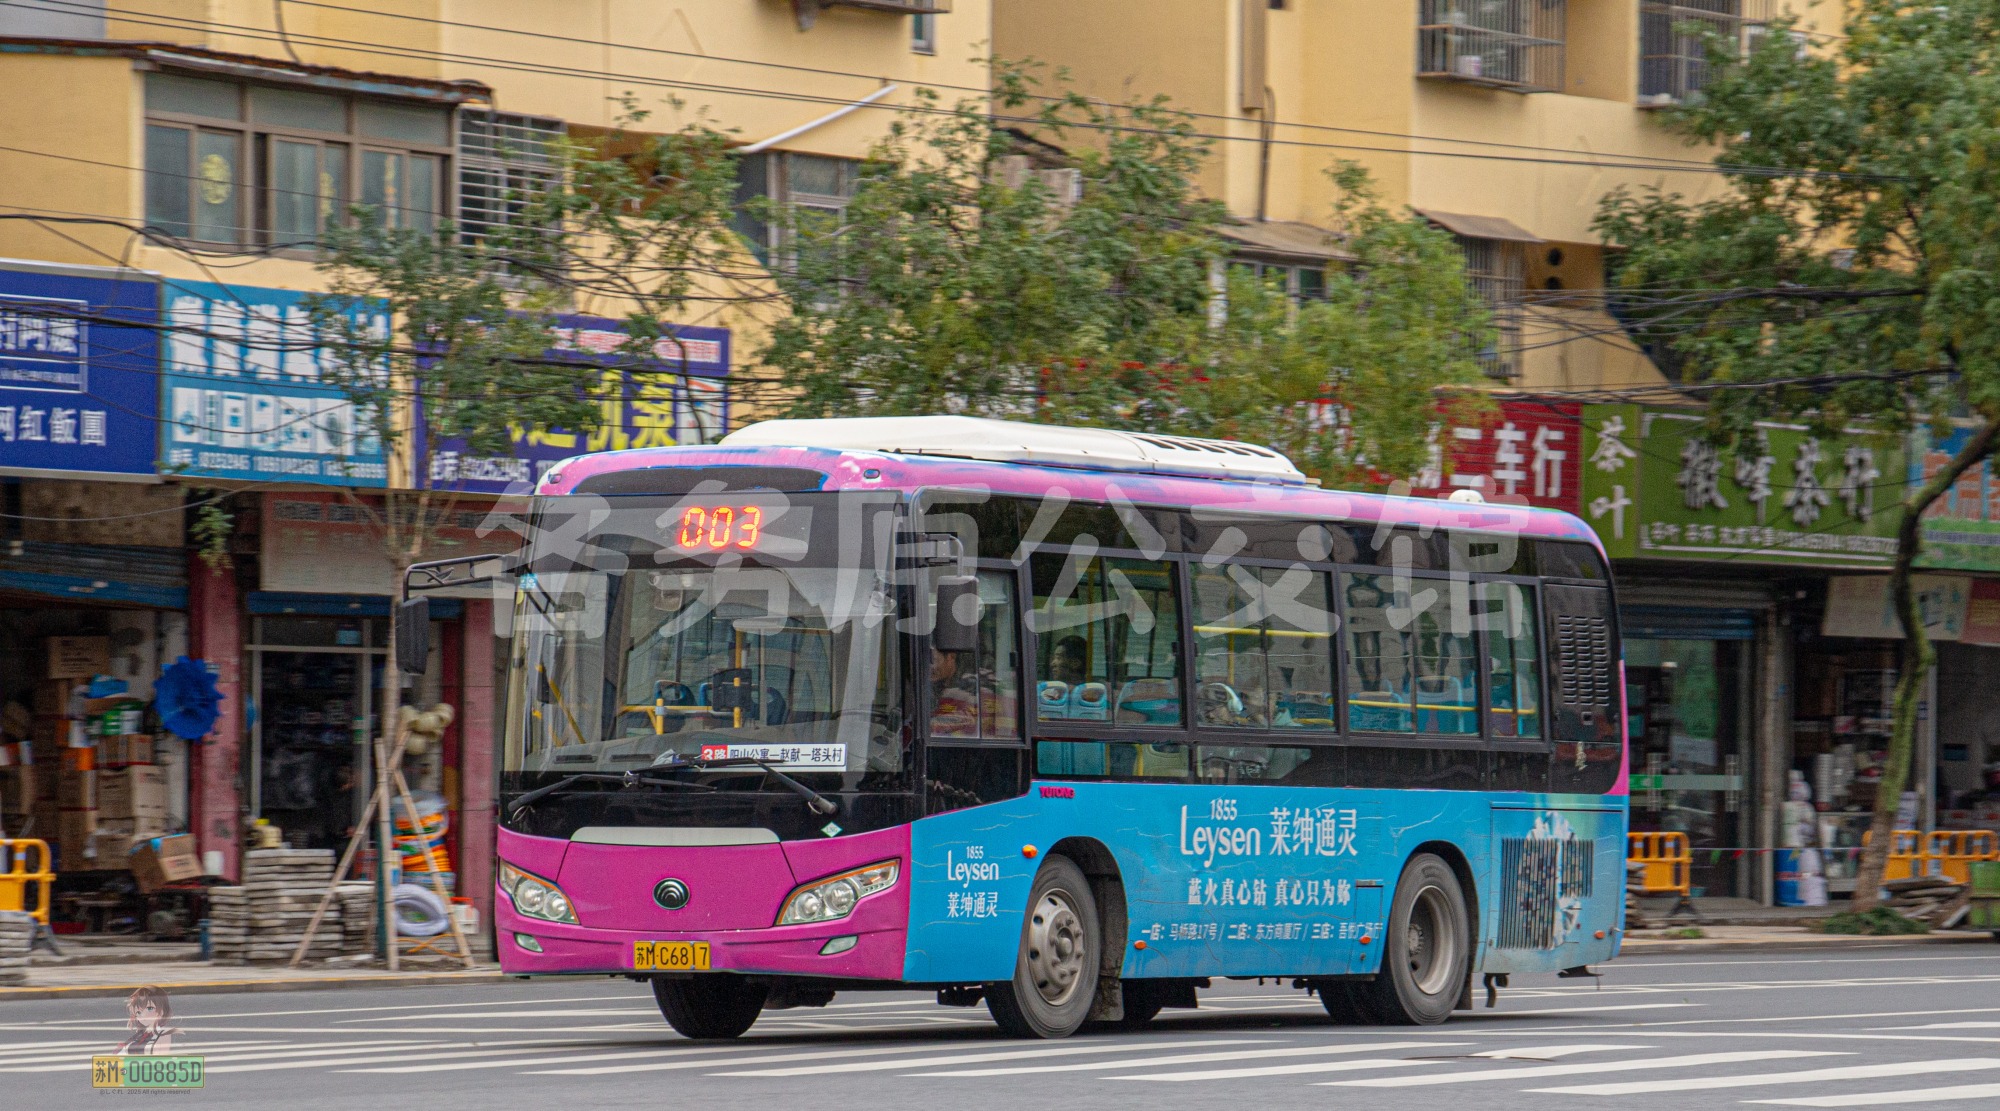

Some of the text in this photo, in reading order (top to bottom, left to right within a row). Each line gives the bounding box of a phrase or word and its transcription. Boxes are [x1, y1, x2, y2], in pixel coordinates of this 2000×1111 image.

[1590, 415, 1637, 540] 茶叶
[682, 507, 761, 548] 003
[1038, 786, 1076, 799] YUTONG
[1210, 799, 1238, 821] 1855
[1180, 804, 1261, 868] Leysen
[1268, 806, 1359, 857] 莱绅通灵
[947, 849, 999, 888] Leysen
[966, 845, 984, 859] 1855
[946, 891, 999, 919] 莱绅通灵
[1187, 877, 1268, 906] 蓝火真心钻
